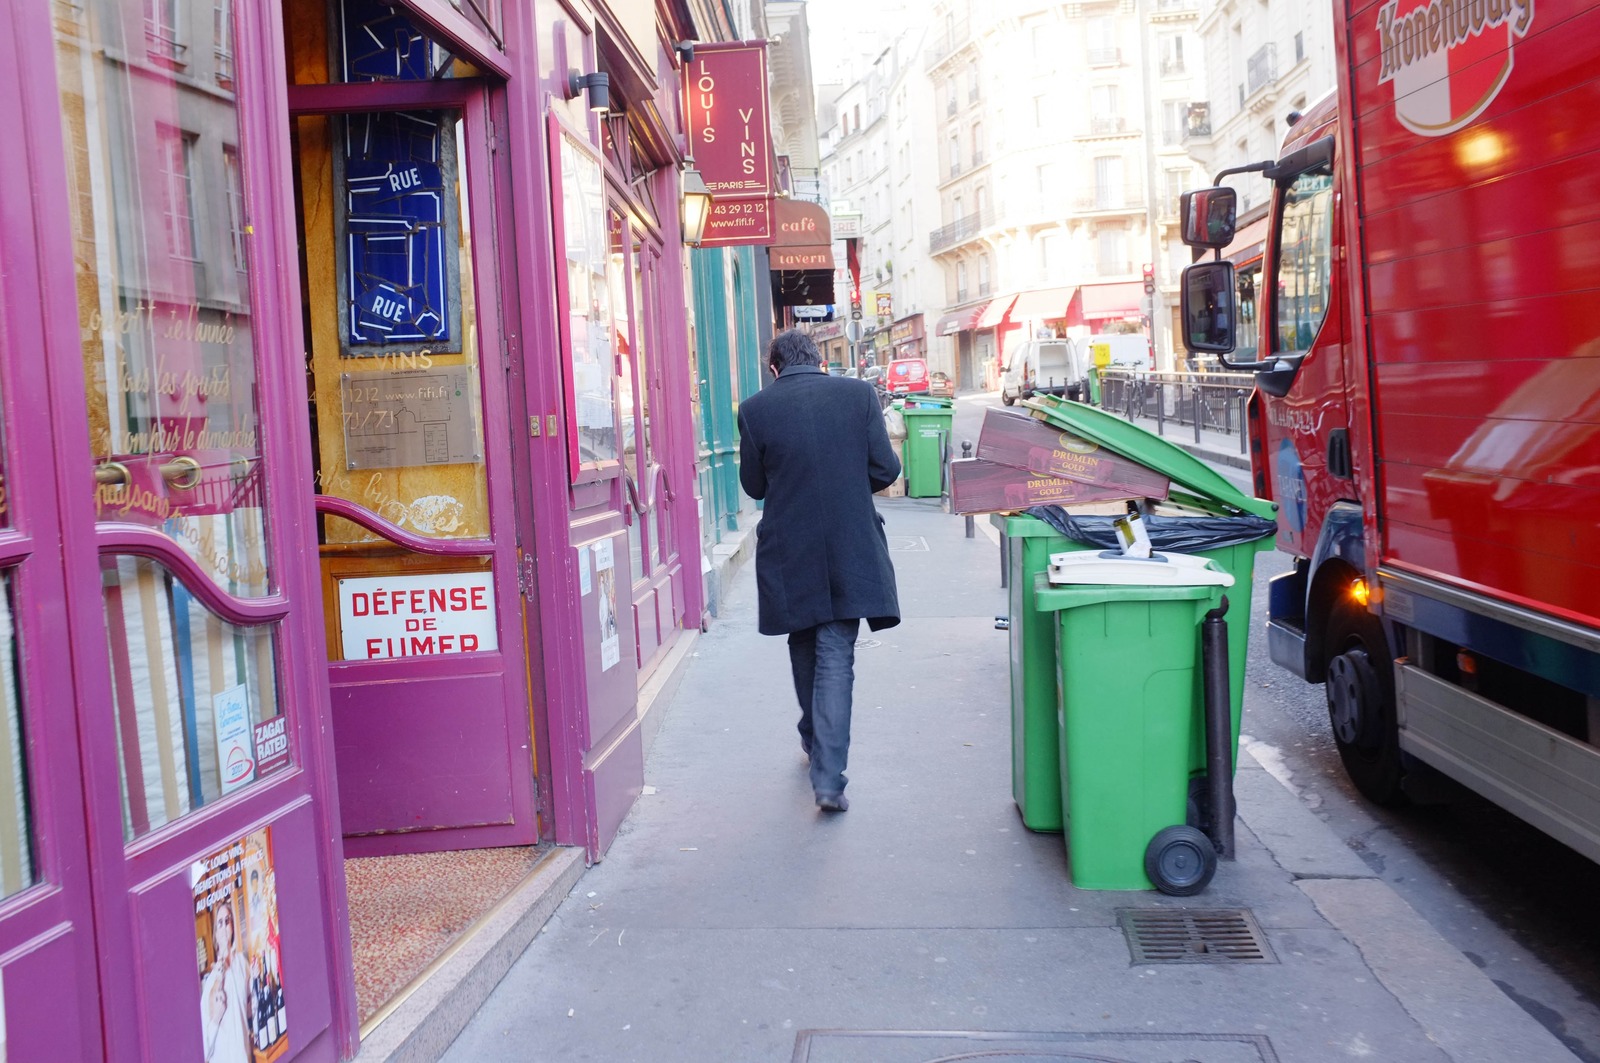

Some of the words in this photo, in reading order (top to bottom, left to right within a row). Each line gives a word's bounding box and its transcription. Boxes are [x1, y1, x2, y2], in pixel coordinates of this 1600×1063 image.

[698, 60, 716, 144] LOUIS
[738, 107, 756, 175] VINS
[388, 167, 421, 192] RUE
[717, 181, 744, 190] PARIS
[714, 205, 727, 215] 43
[729, 204, 741, 214] 29
[743, 203, 753, 213] 12
[755, 203, 765, 213] 12
[710, 217, 756, 228] www.fifi.fr
[781, 217, 816, 232] café
[779, 254, 827, 265] tavern
[371, 295, 405, 322] RUE
[373, 349, 433, 371] VINS
[120, 420, 181, 468] ompris
[1052, 449, 1099, 466] DRUMLIN
[1062, 461, 1085, 472] GOLD
[1039, 487, 1063, 496] GOLD
[352, 586, 488, 617] DÉFENSE
[405, 617, 437, 632] DE
[366, 633, 479, 659] FUMER
[255, 716, 286, 745] ZAGAT
[257, 733, 288, 762] RATED
